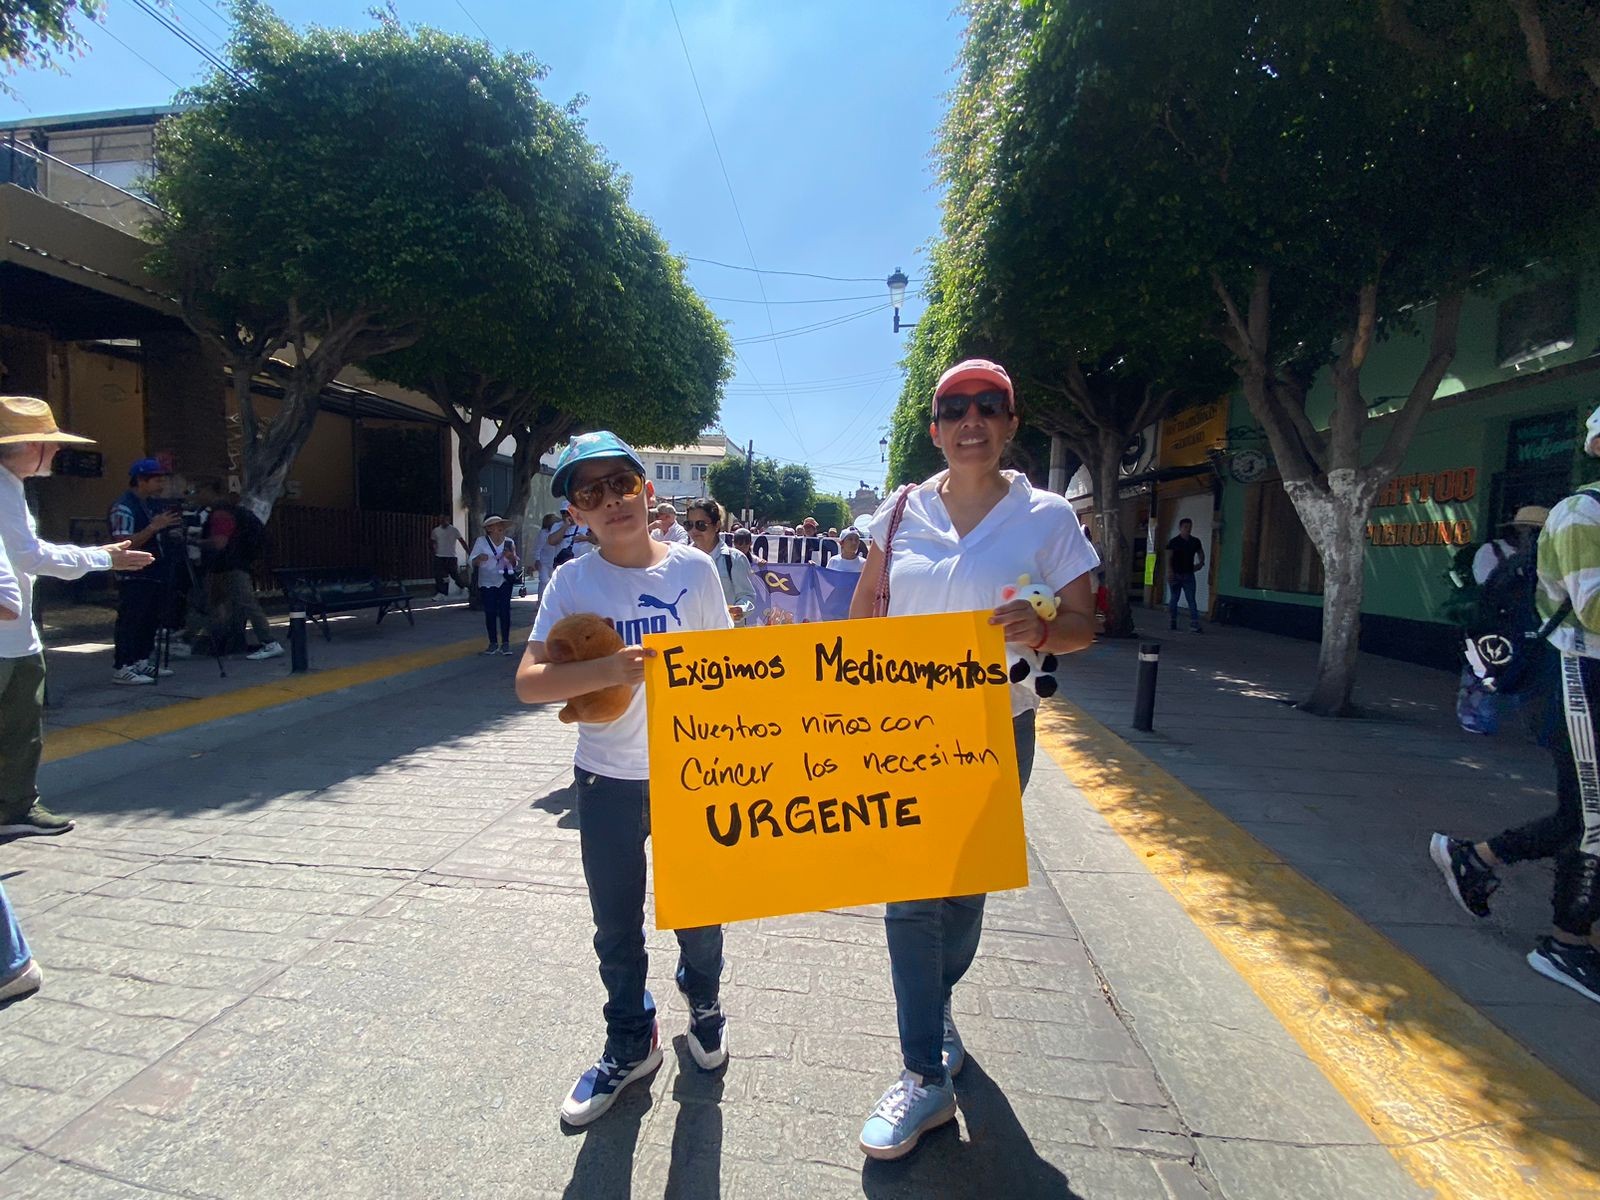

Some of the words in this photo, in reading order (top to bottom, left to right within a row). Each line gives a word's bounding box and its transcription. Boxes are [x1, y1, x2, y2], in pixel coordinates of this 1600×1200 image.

[1373, 468, 1477, 506] ATTOO
[663, 646, 785, 690] Exigimos
[815, 636, 1007, 690] Medicamentos
[1563, 655, 1587, 714] MOVEMENT
[673, 713, 782, 742] Nuestros
[802, 713, 872, 736] niños
[881, 713, 935, 732] con
[804, 753, 838, 781] los
[864, 739, 999, 774] necesitan
[706, 791, 921, 847] URGENTE
